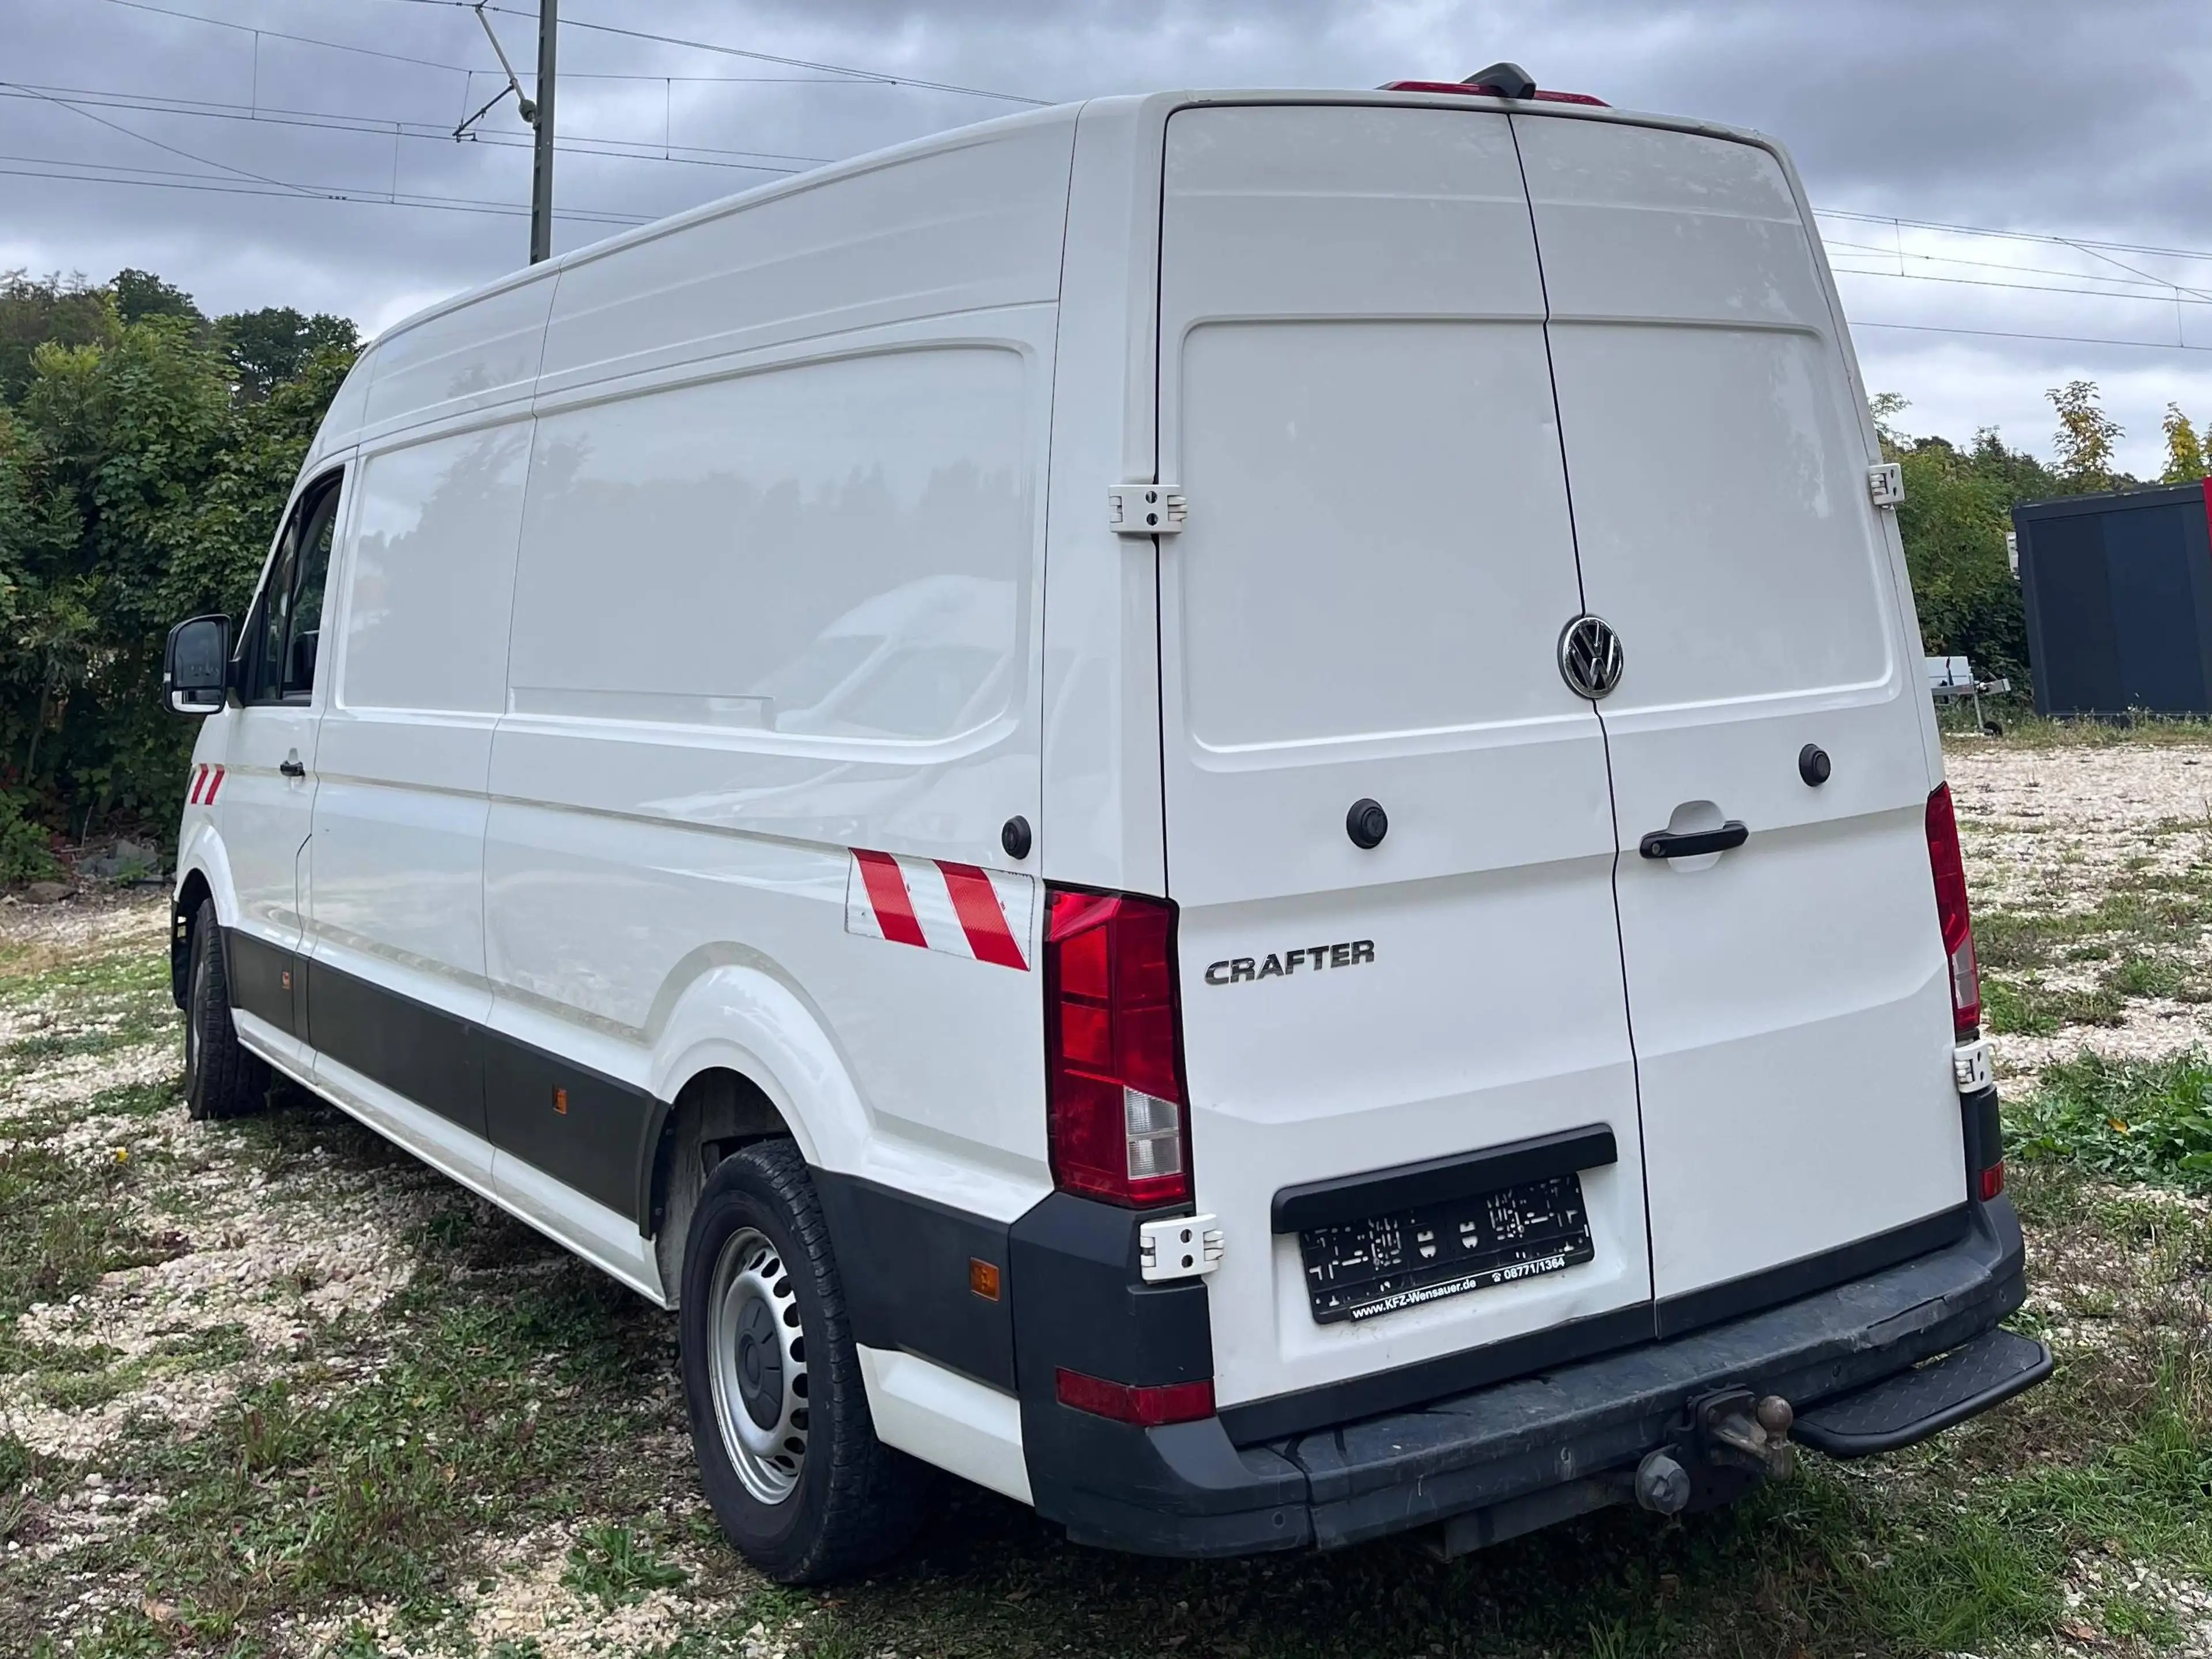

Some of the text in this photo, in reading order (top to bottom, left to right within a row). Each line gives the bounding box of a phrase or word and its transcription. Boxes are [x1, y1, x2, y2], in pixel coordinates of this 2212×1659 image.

[1565, 619, 1621, 695] VW
[1205, 939, 1375, 986] CRAFTER
[1352, 1256, 1566, 1320] www.KFZ-Wensauer.de 08771/1364
